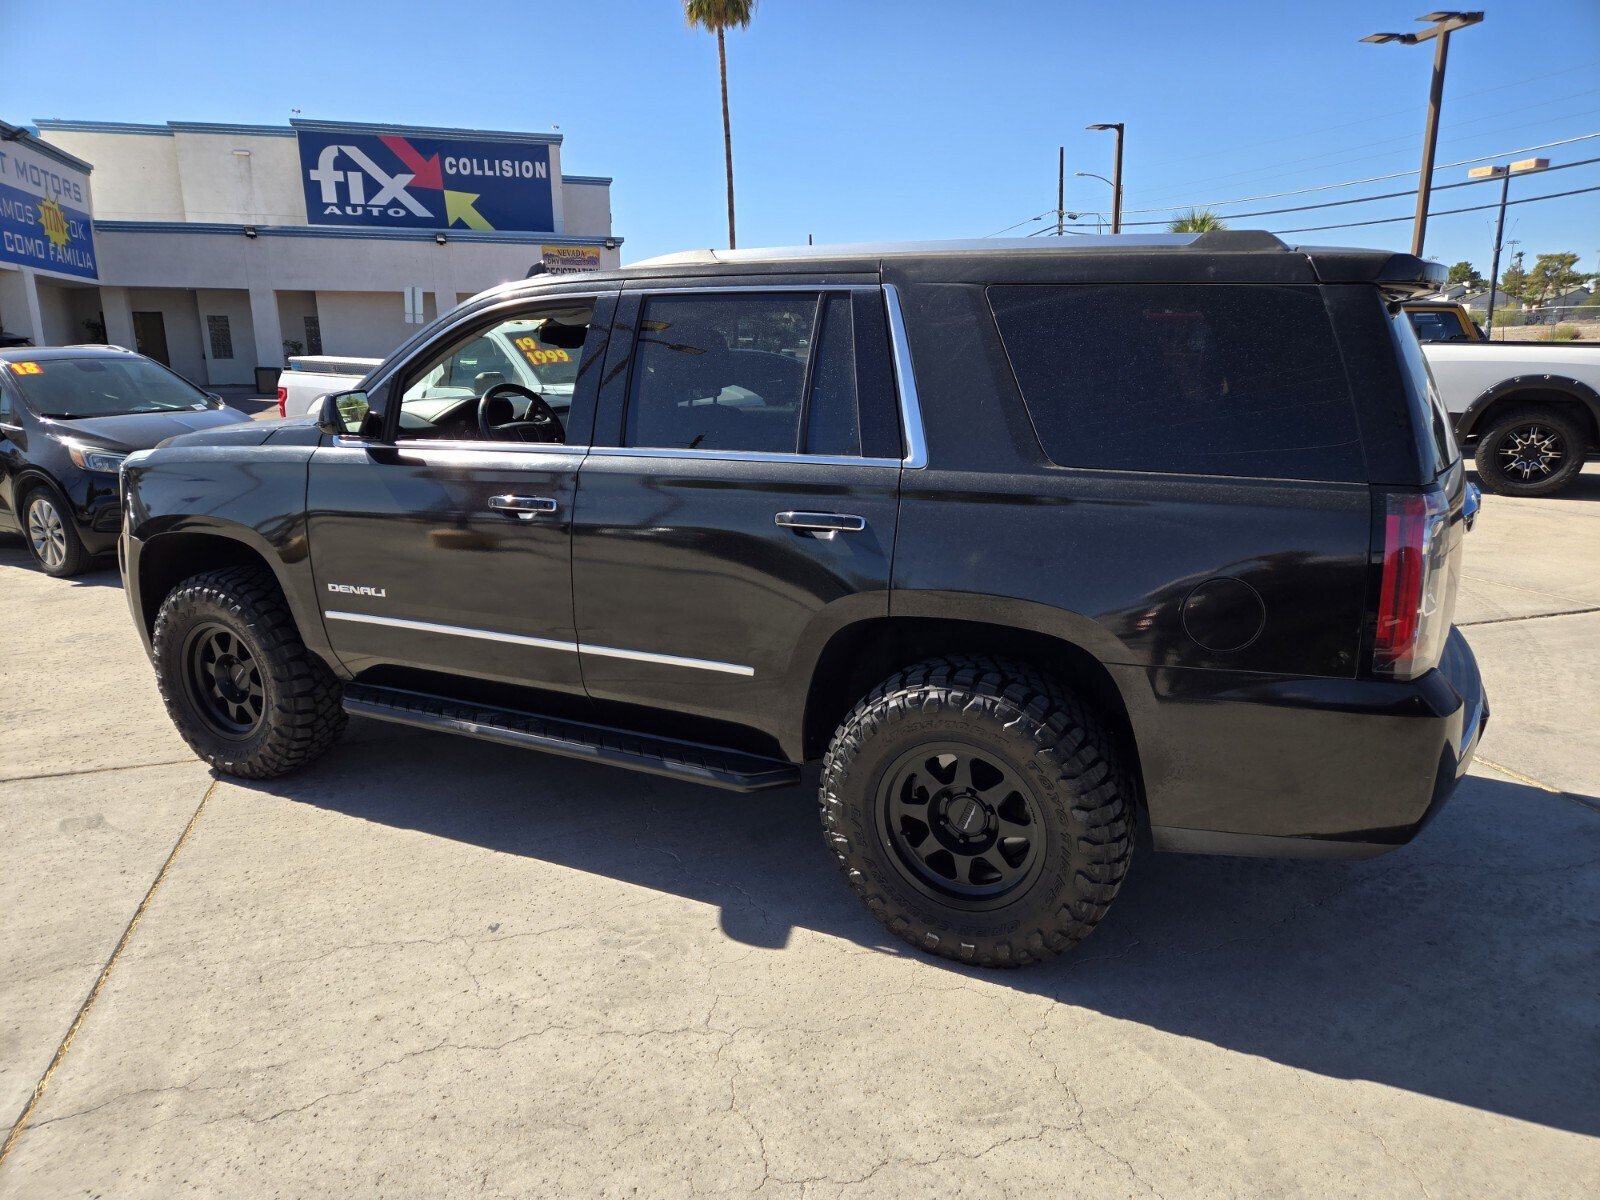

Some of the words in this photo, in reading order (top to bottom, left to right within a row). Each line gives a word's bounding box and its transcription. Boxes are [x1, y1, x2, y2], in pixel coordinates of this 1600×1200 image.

[444, 156, 547, 179] COLLISION
[14, 157, 82, 203] MOTORS
[309, 145, 435, 218] fix
[0, 197, 35, 226] MOS
[69, 219, 86, 241] OK
[43, 204, 65, 235] ITIN
[323, 205, 407, 217] AUTO
[3, 231, 45, 260] COMO
[48, 242, 94, 271] FAMILIA
[557, 248, 585, 257] NEVADA
[515, 337, 537, 351] 19
[526, 349, 570, 366] 1999
[11, 361, 41, 375] 18
[327, 583, 387, 598] DENALI
